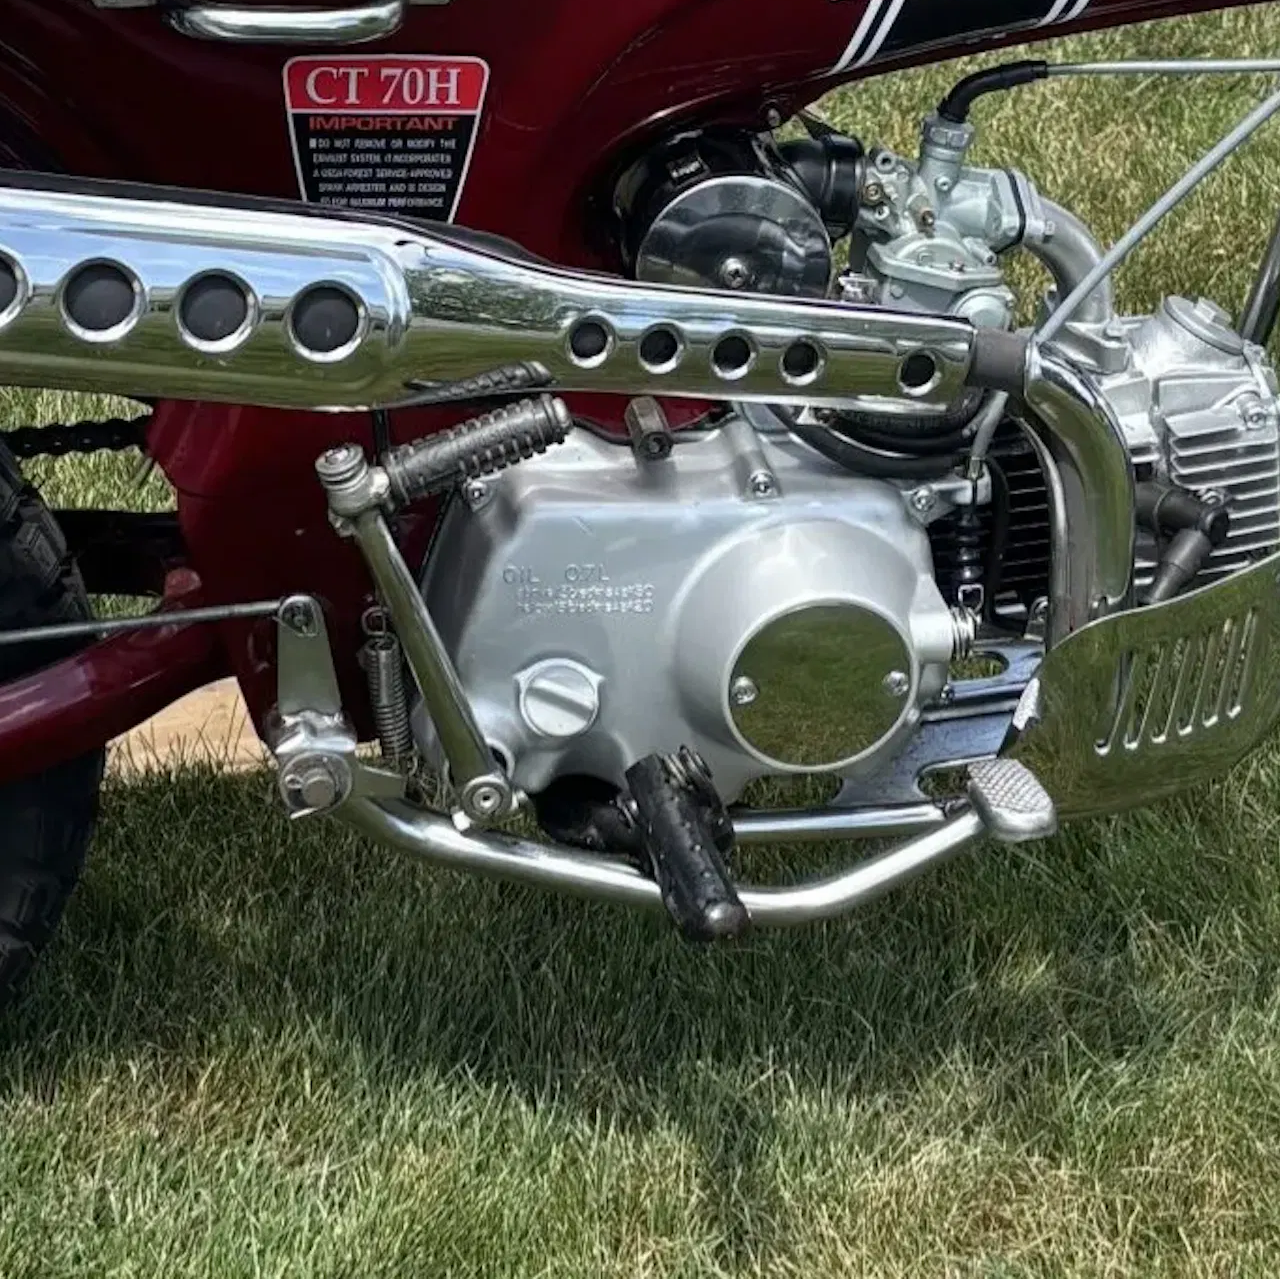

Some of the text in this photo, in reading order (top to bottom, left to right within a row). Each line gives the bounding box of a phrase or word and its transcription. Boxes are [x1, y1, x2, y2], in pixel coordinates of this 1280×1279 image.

[305, 66, 462, 106] CT 70H
[308, 116, 459, 131] IMPORTANT
[502, 563, 540, 584] OIL
